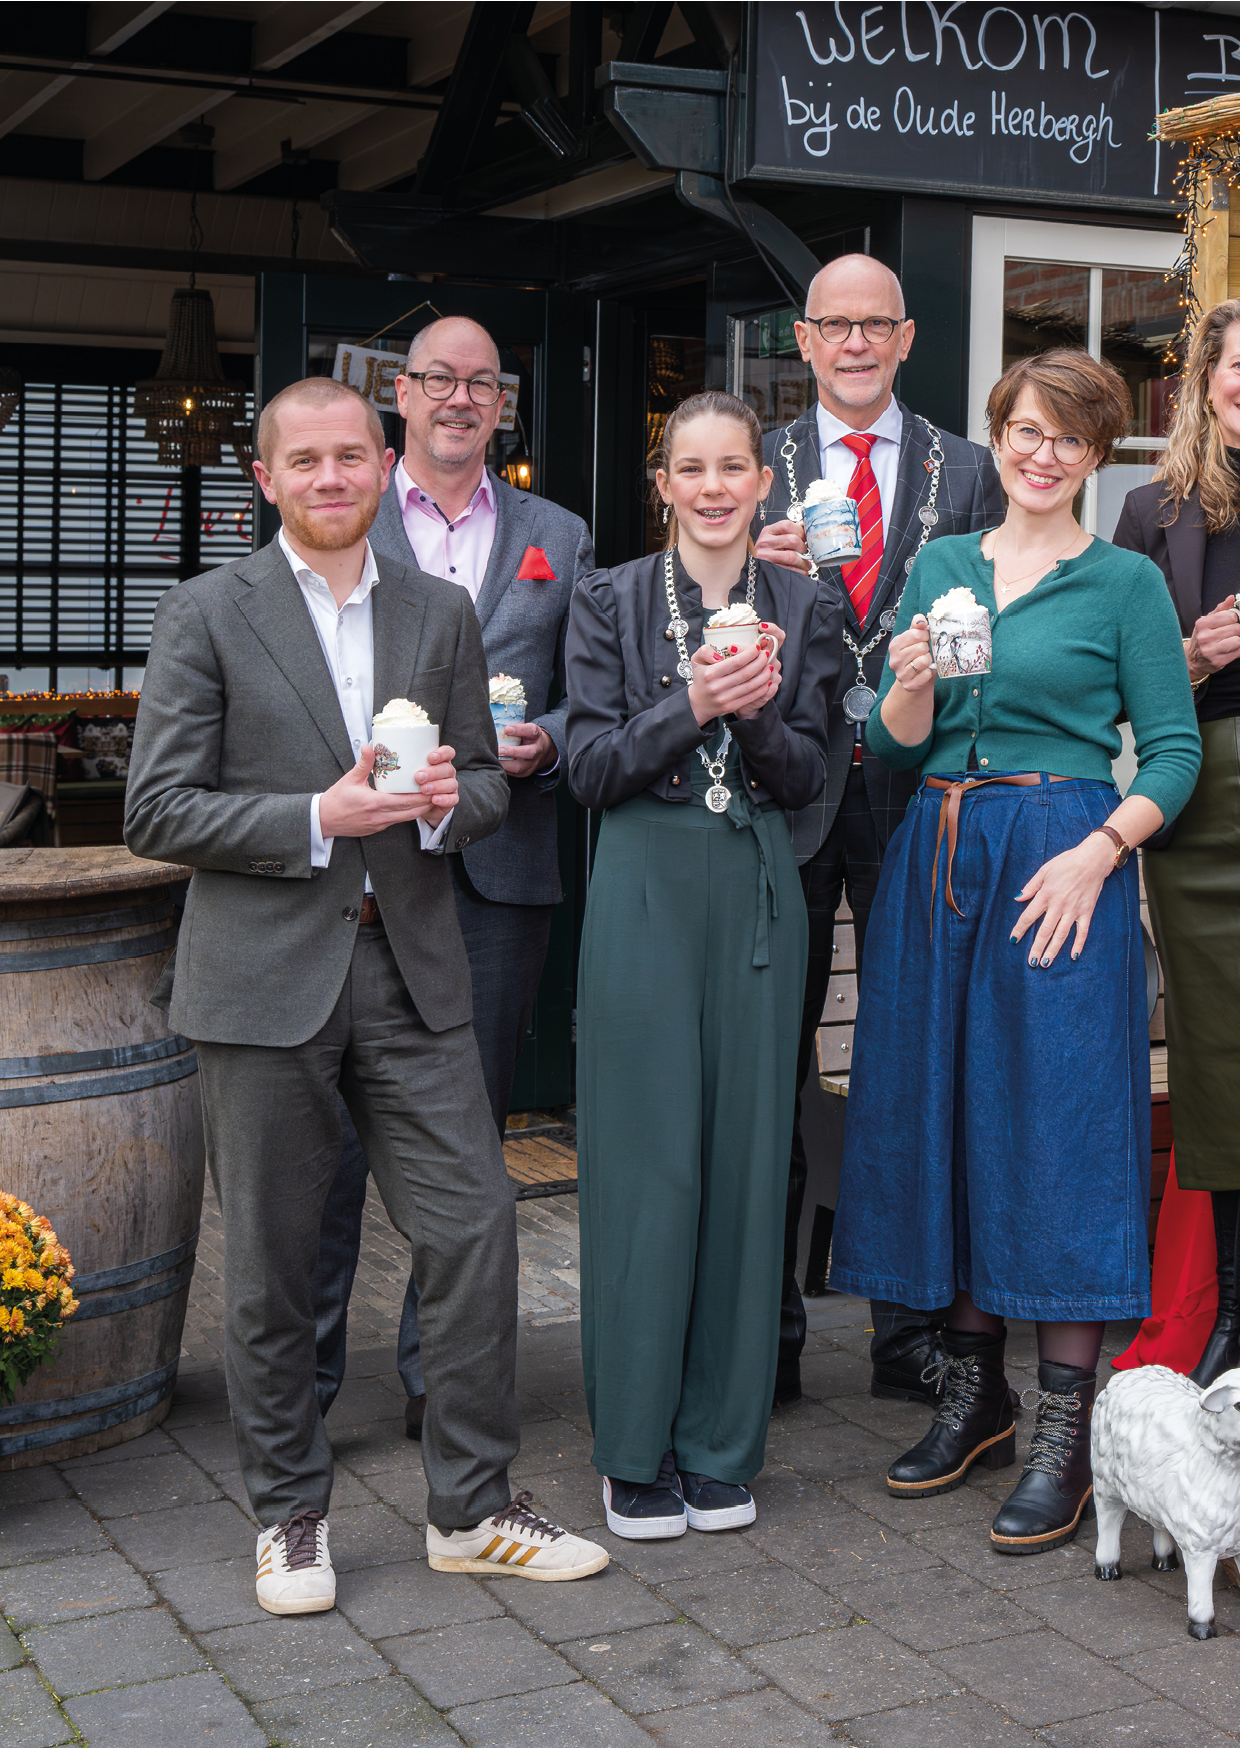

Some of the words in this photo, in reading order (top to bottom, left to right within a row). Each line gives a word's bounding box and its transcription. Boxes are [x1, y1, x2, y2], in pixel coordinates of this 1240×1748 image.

[796, 0, 1109, 79] WELKOM
[781, 75, 838, 157] bij
[846, 96, 881, 131] de
[893, 86, 975, 136] Oude
[991, 90, 1122, 164] Herbergh
